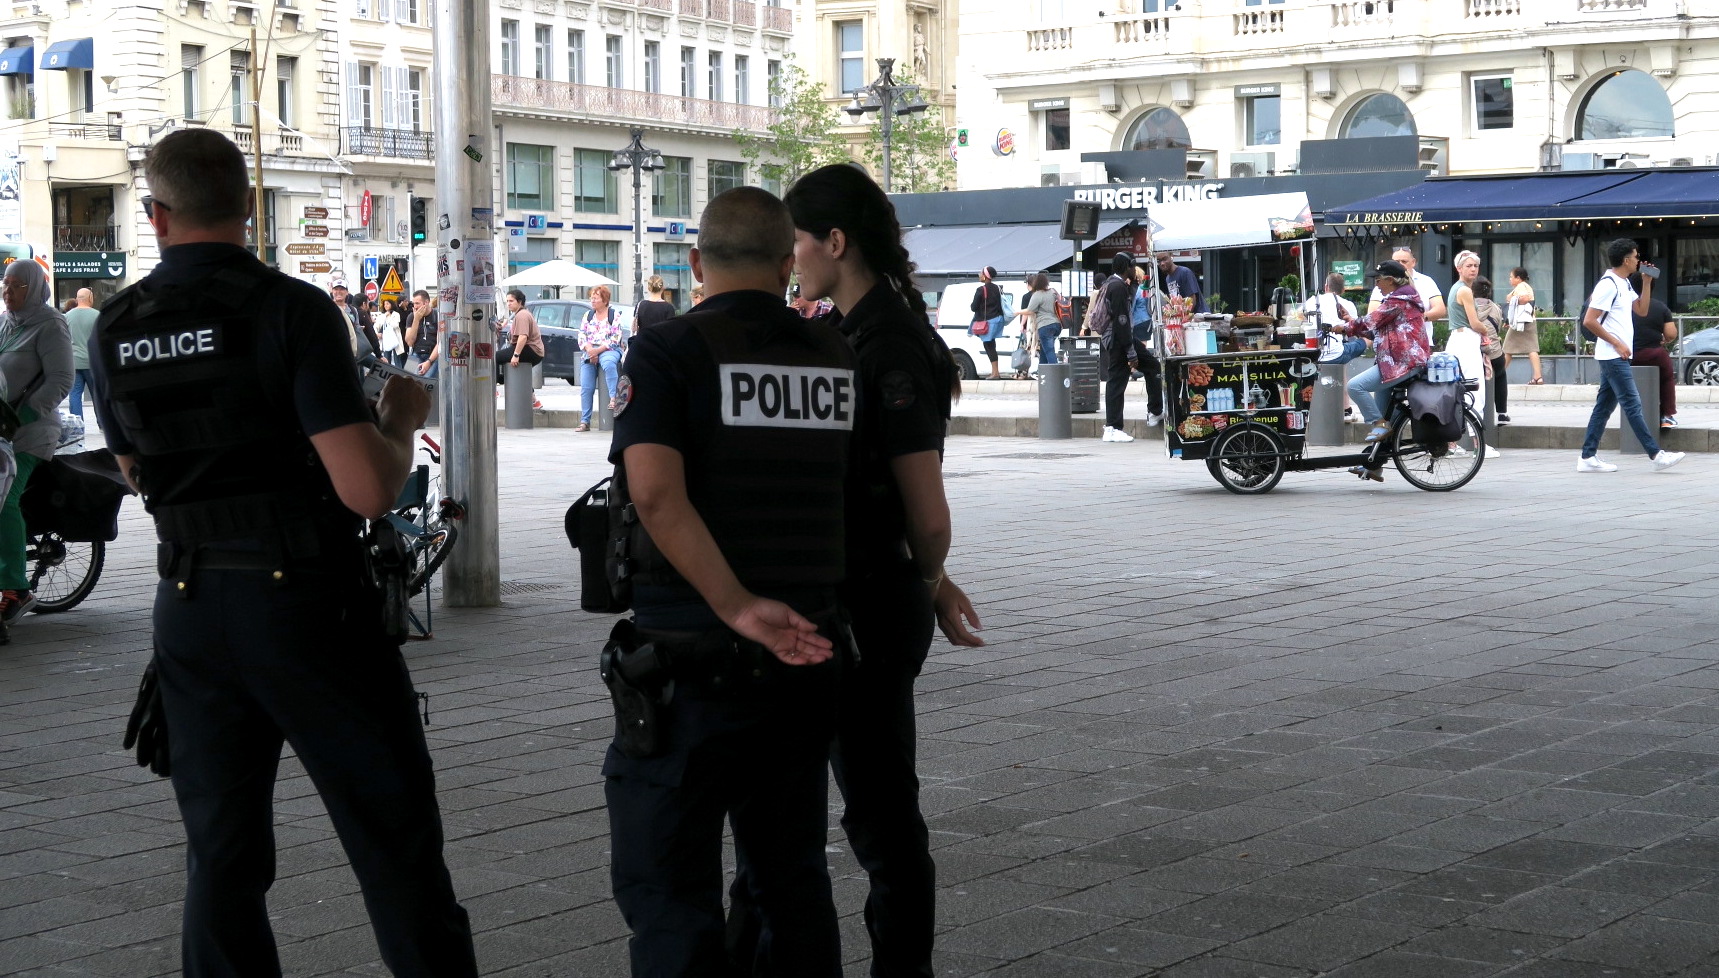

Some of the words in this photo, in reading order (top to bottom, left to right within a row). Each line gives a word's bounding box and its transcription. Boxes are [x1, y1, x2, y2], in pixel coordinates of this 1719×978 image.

[999, 138, 1013, 151] KING
[1163, 183, 1218, 203] KING
[1345, 213, 1359, 223] LA
[1364, 211, 1424, 223] BRASSERIE
[119, 329, 215, 365] POLICE
[1222, 354, 1280, 368] LATIFA
[1217, 371, 1286, 383] MARSILIA
[730, 372, 850, 421] POLICE
